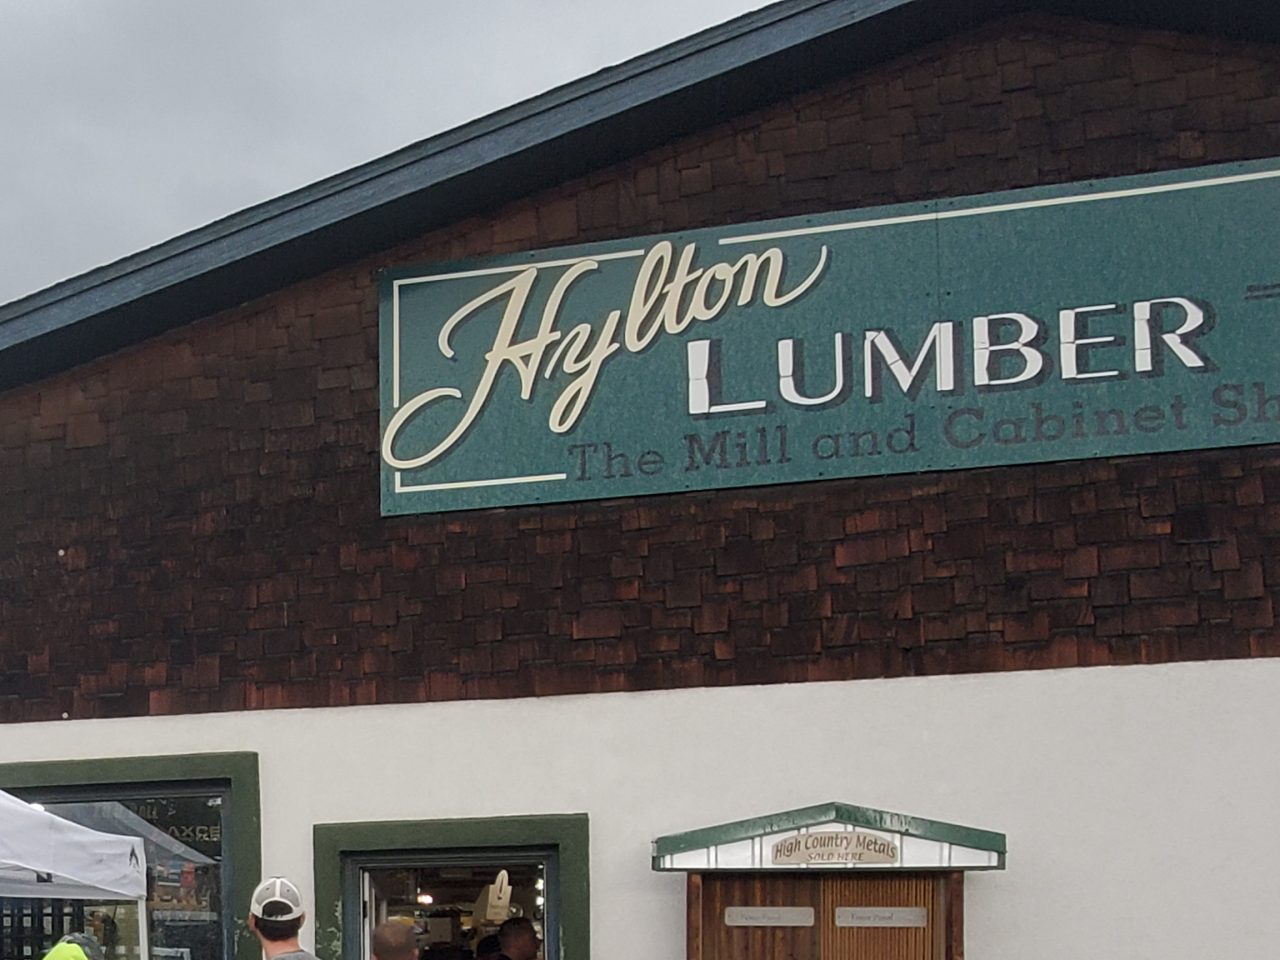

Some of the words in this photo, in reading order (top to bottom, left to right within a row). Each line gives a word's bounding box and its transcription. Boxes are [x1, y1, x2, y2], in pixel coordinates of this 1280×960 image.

[382, 241, 828, 469] Hylton
[687, 297, 1205, 415] LUMBER
[568, 441, 665, 482] The
[683, 425, 793, 473] Mill
[812, 413, 921, 461] and
[943, 394, 1189, 450] Cabinet
[775, 837, 801, 860] High
[805, 833, 852, 850] Country
[856, 834, 897, 859] Metals
[808, 852, 835, 861] SOLD
[837, 852, 864, 861] HERE
